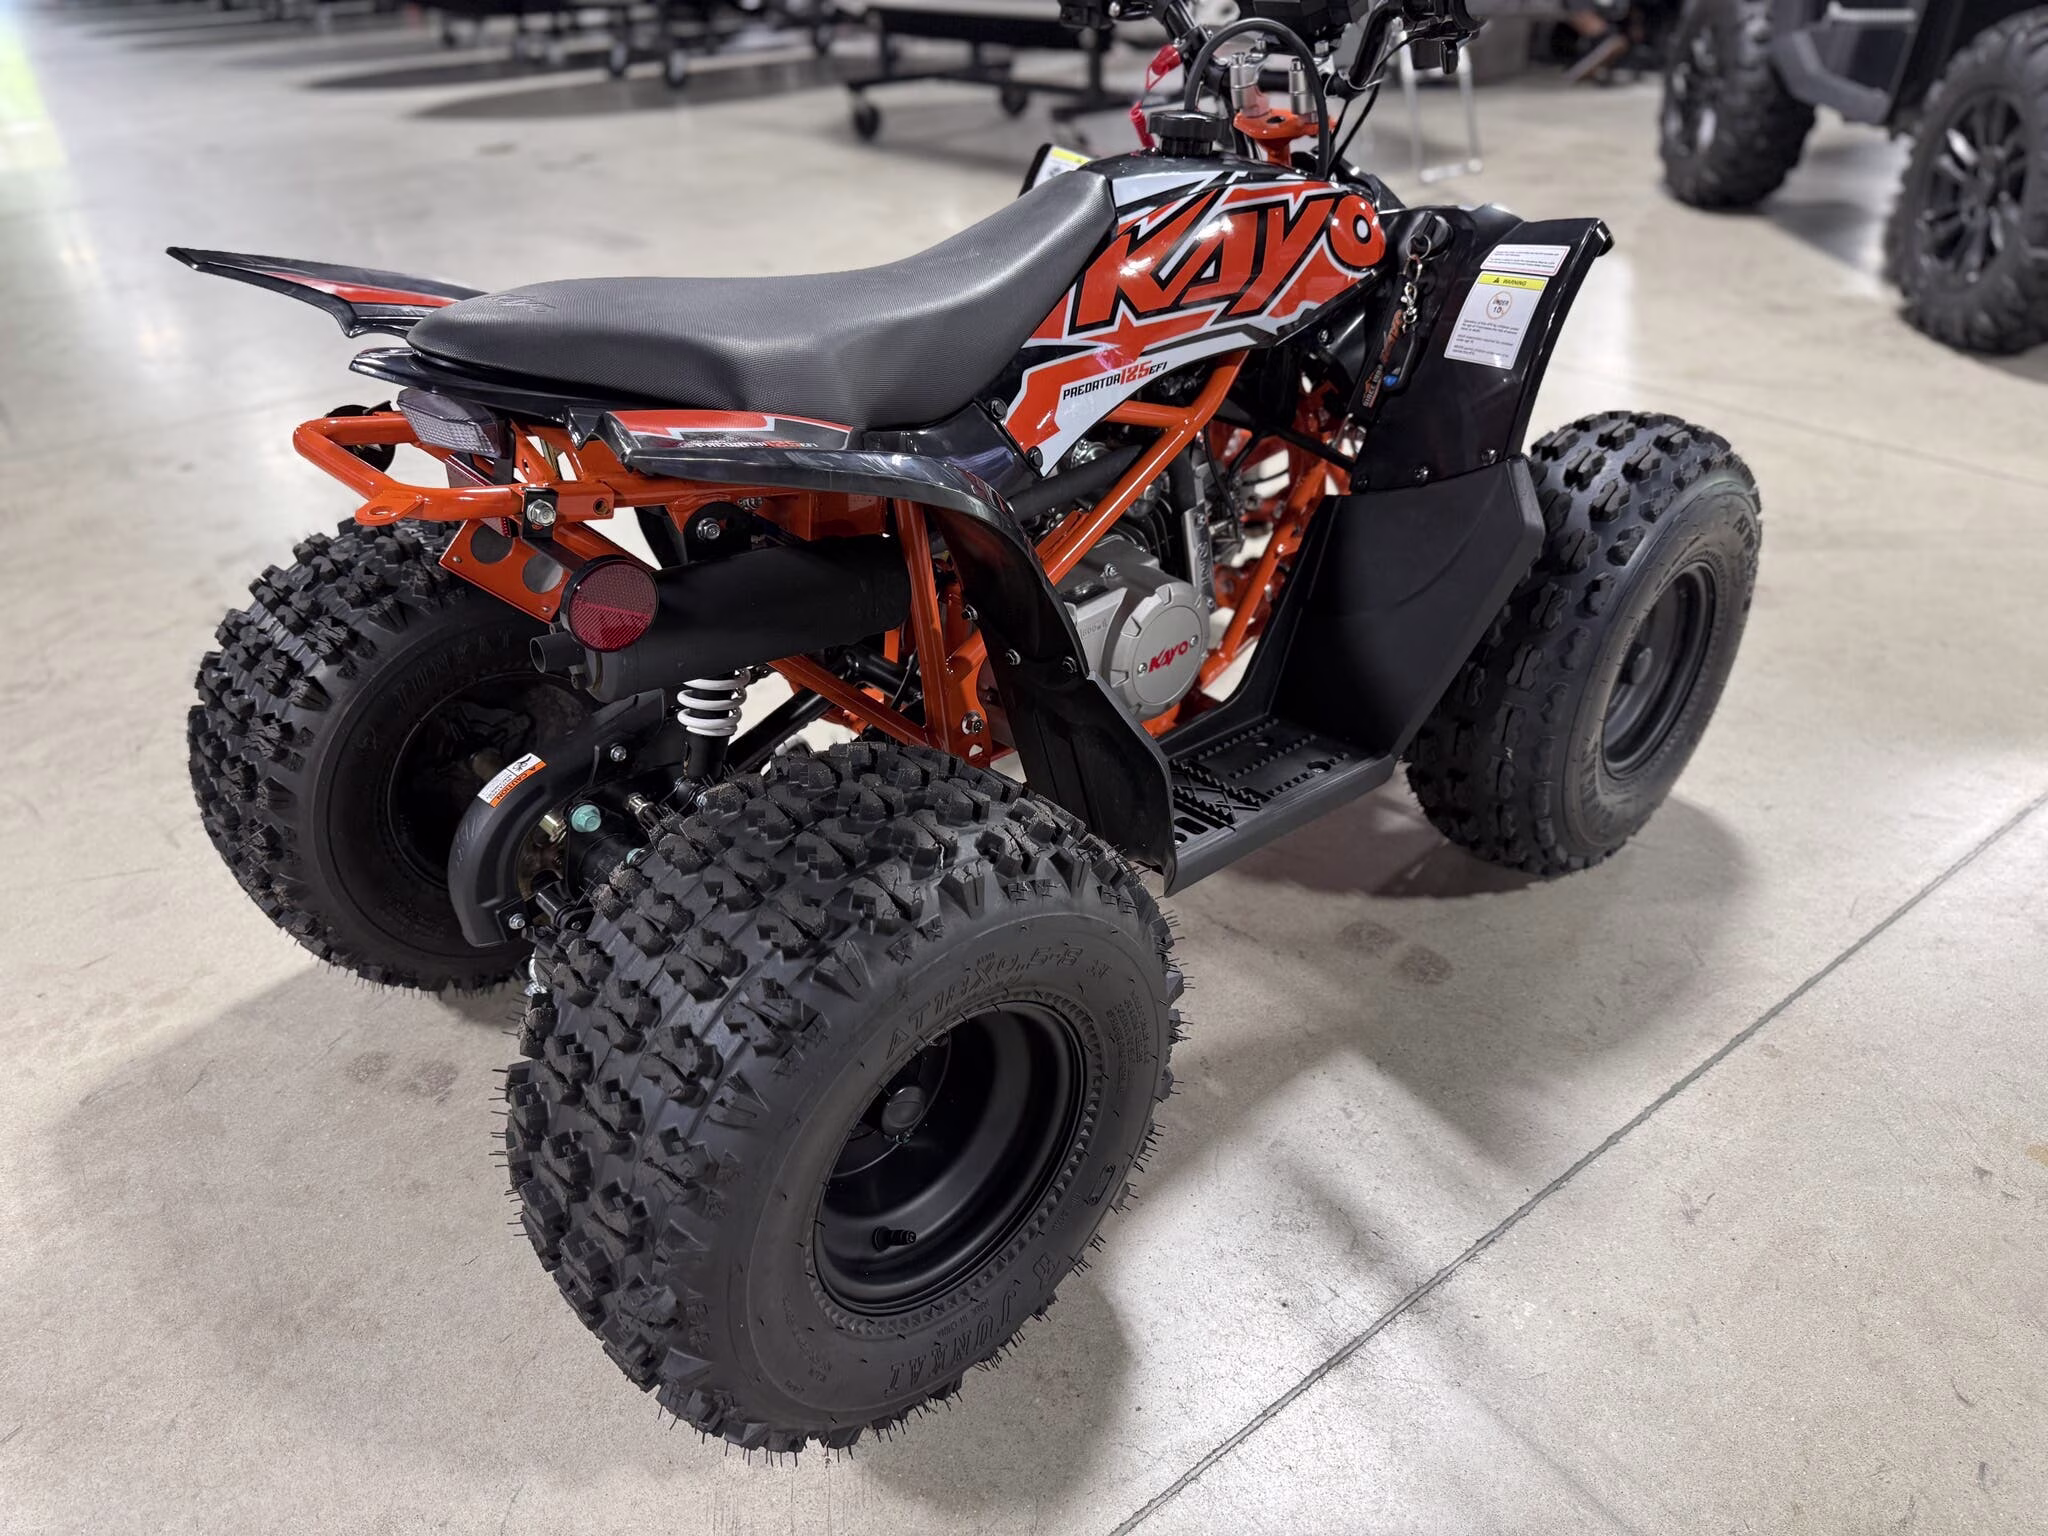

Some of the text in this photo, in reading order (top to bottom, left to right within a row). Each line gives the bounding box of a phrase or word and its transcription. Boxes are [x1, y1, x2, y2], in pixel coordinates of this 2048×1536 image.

[1068, 188, 1386, 336] KAYO
[1502, 278, 1528, 287] WARNING
[496, 773, 528, 800] CAUTION
